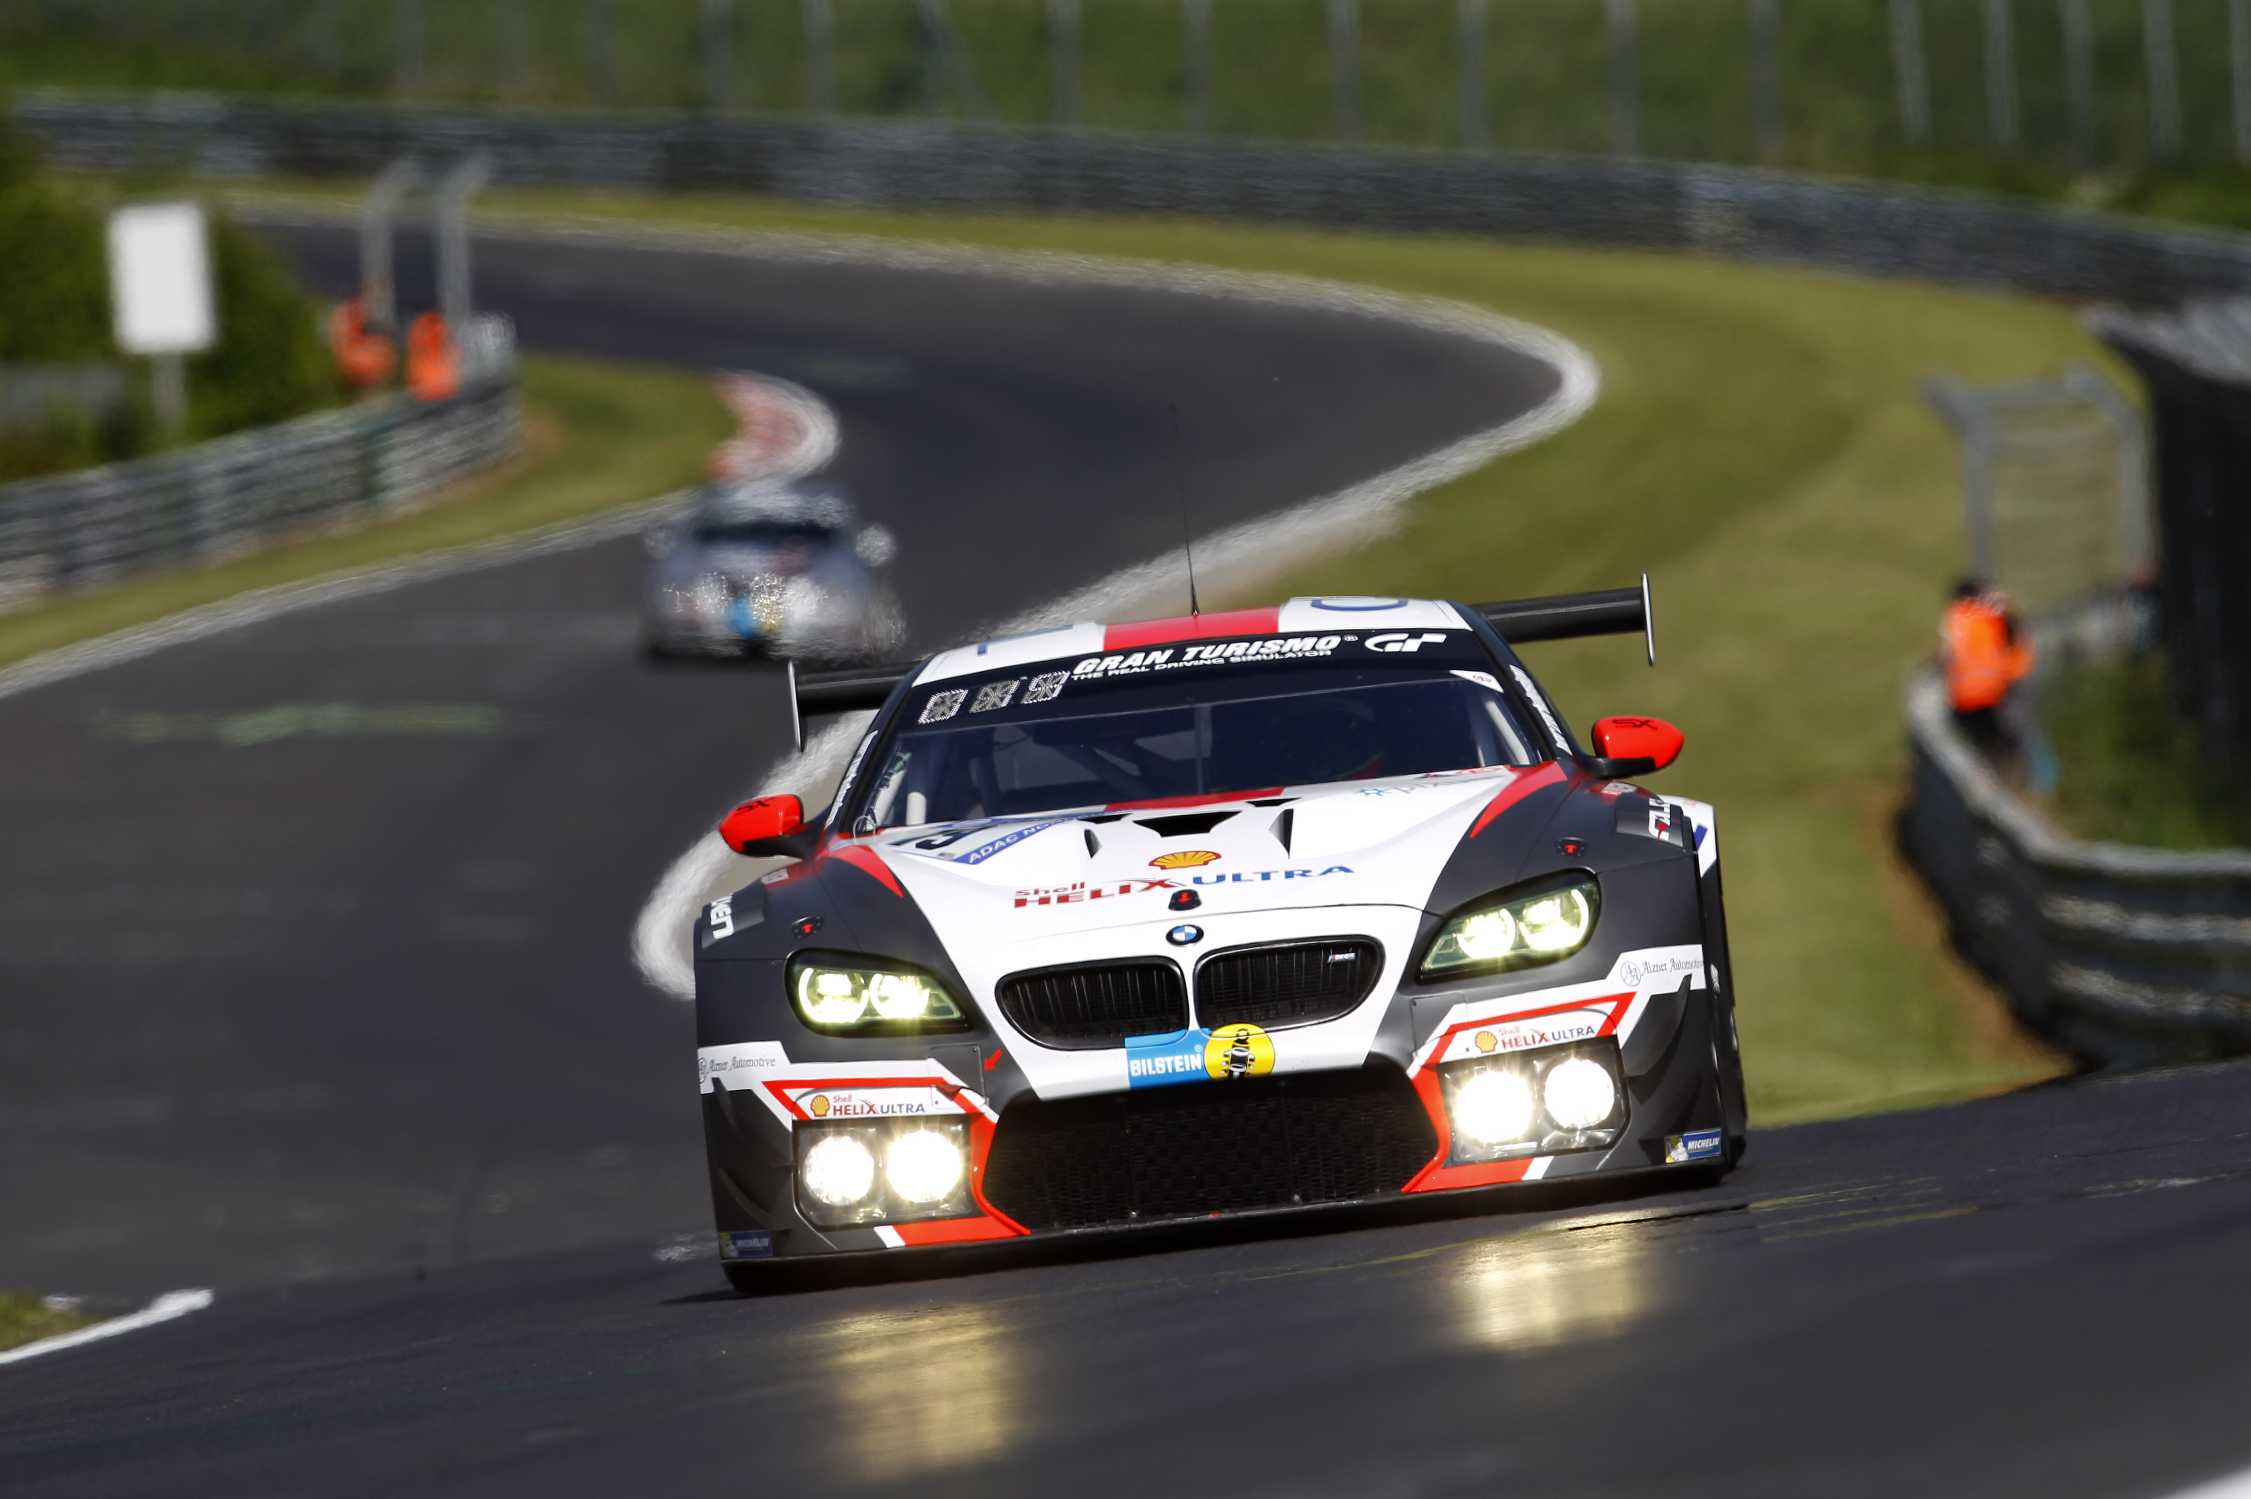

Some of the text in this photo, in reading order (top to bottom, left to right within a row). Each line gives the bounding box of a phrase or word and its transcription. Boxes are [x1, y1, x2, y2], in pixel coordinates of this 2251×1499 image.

[1071, 649, 1332, 681] THE REAL DRIVING SIMULATOR
[1072, 635, 1342, 675] GRAN TURISMO
[968, 833, 1018, 864] ADAC
[1014, 865, 1355, 908] HELIX ULTRA
[1015, 881, 1086, 897] Shell
[1501, 1025, 1596, 1049] HELIX ULTRA
[1129, 1054, 1202, 1077] BILSTEIN
[833, 1103, 926, 1116] HELIX ULTRA
